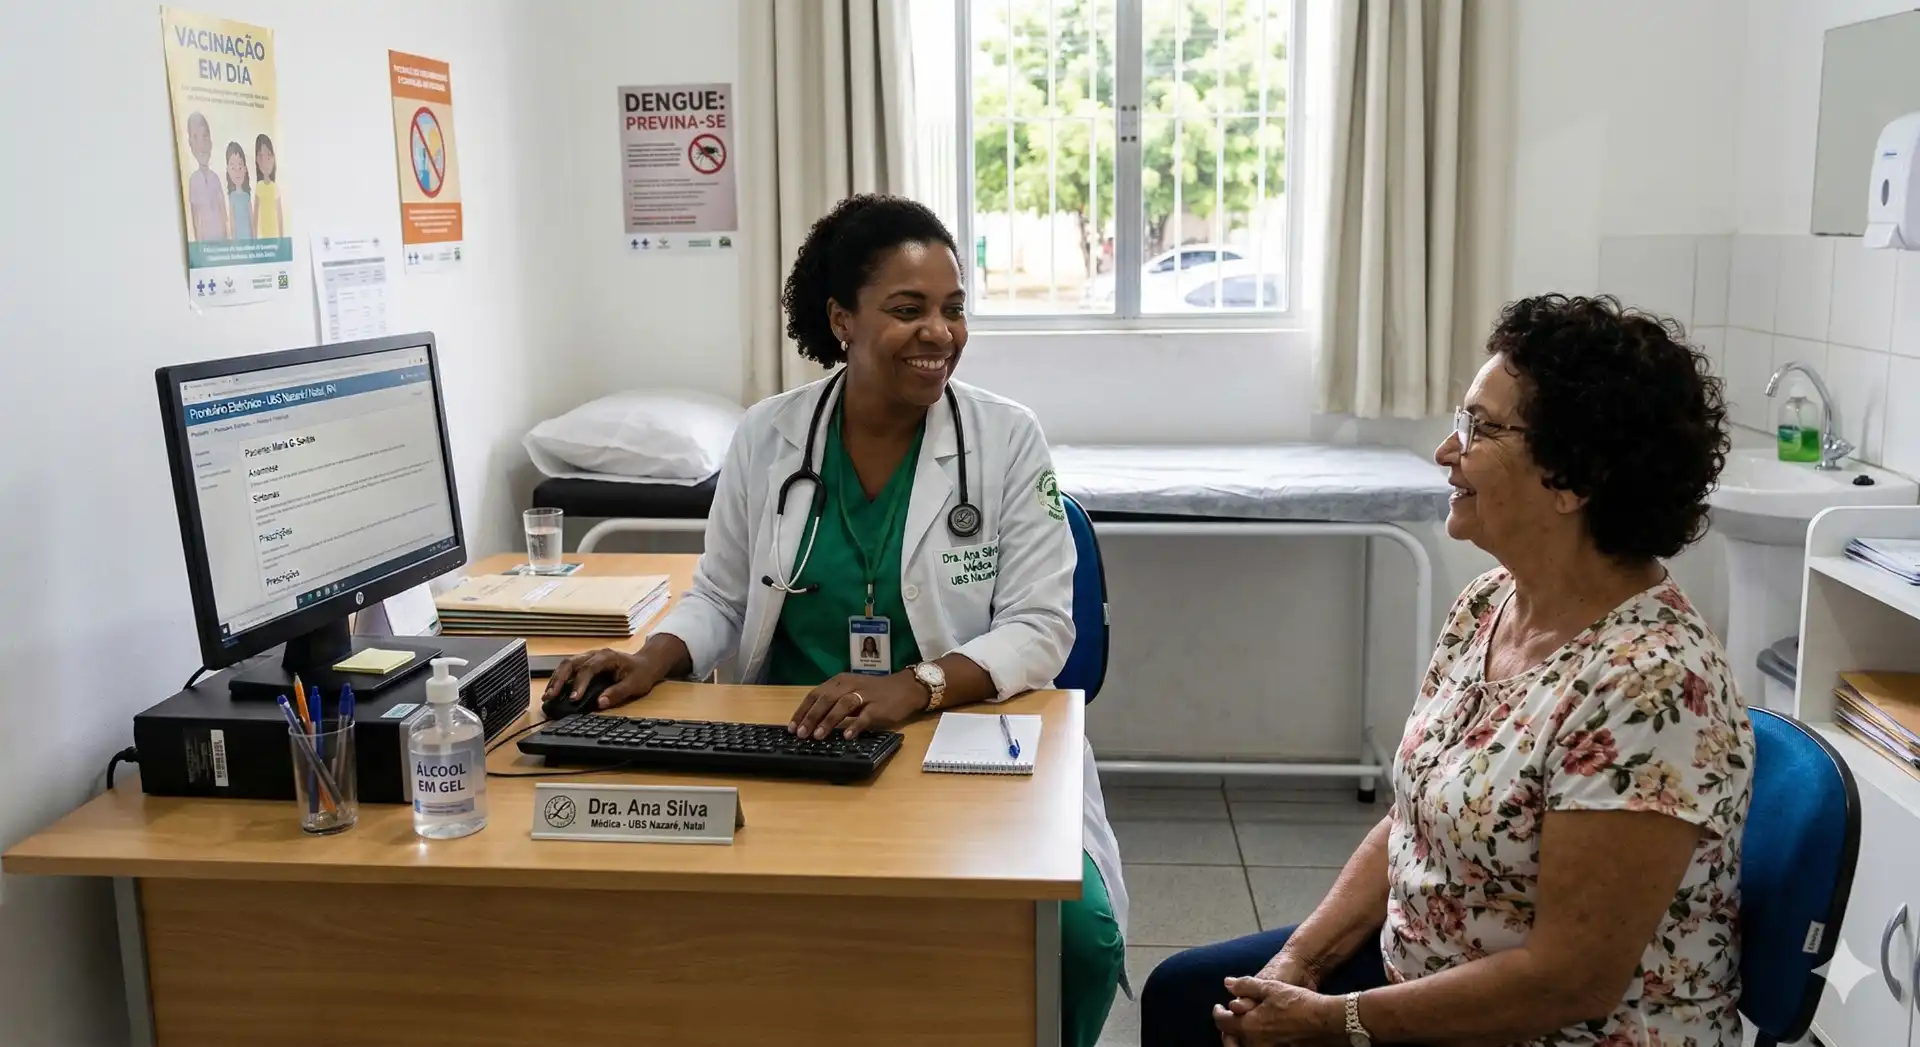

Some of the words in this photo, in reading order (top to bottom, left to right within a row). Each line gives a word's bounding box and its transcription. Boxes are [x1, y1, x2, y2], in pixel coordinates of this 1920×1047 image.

[174, 25, 265, 63] VACINAÇÃO
[199, 58, 221, 81] EM
[226, 63, 252, 85] DIA
[625, 91, 725, 112] DENGUE:
[626, 114, 726, 130] PREVINA-SE
[266, 393, 282, 405] UBS
[942, 553, 961, 564] Dra.
[963, 550, 980, 561] Ana
[963, 560, 992, 573] Médica
[951, 574, 970, 585] UBS
[416, 761, 467, 777] ÁLCOOL
[418, 780, 436, 793] EM
[439, 780, 465, 793] GEL
[588, 798, 622, 815] Dra.
[627, 799, 661, 816] Ana
[667, 800, 708, 817] Silva
[591, 819, 621, 828] Médica
[628, 820, 647, 829] UBS
[649, 820, 681, 831] Nazaré,
[683, 821, 706, 830] Natal
